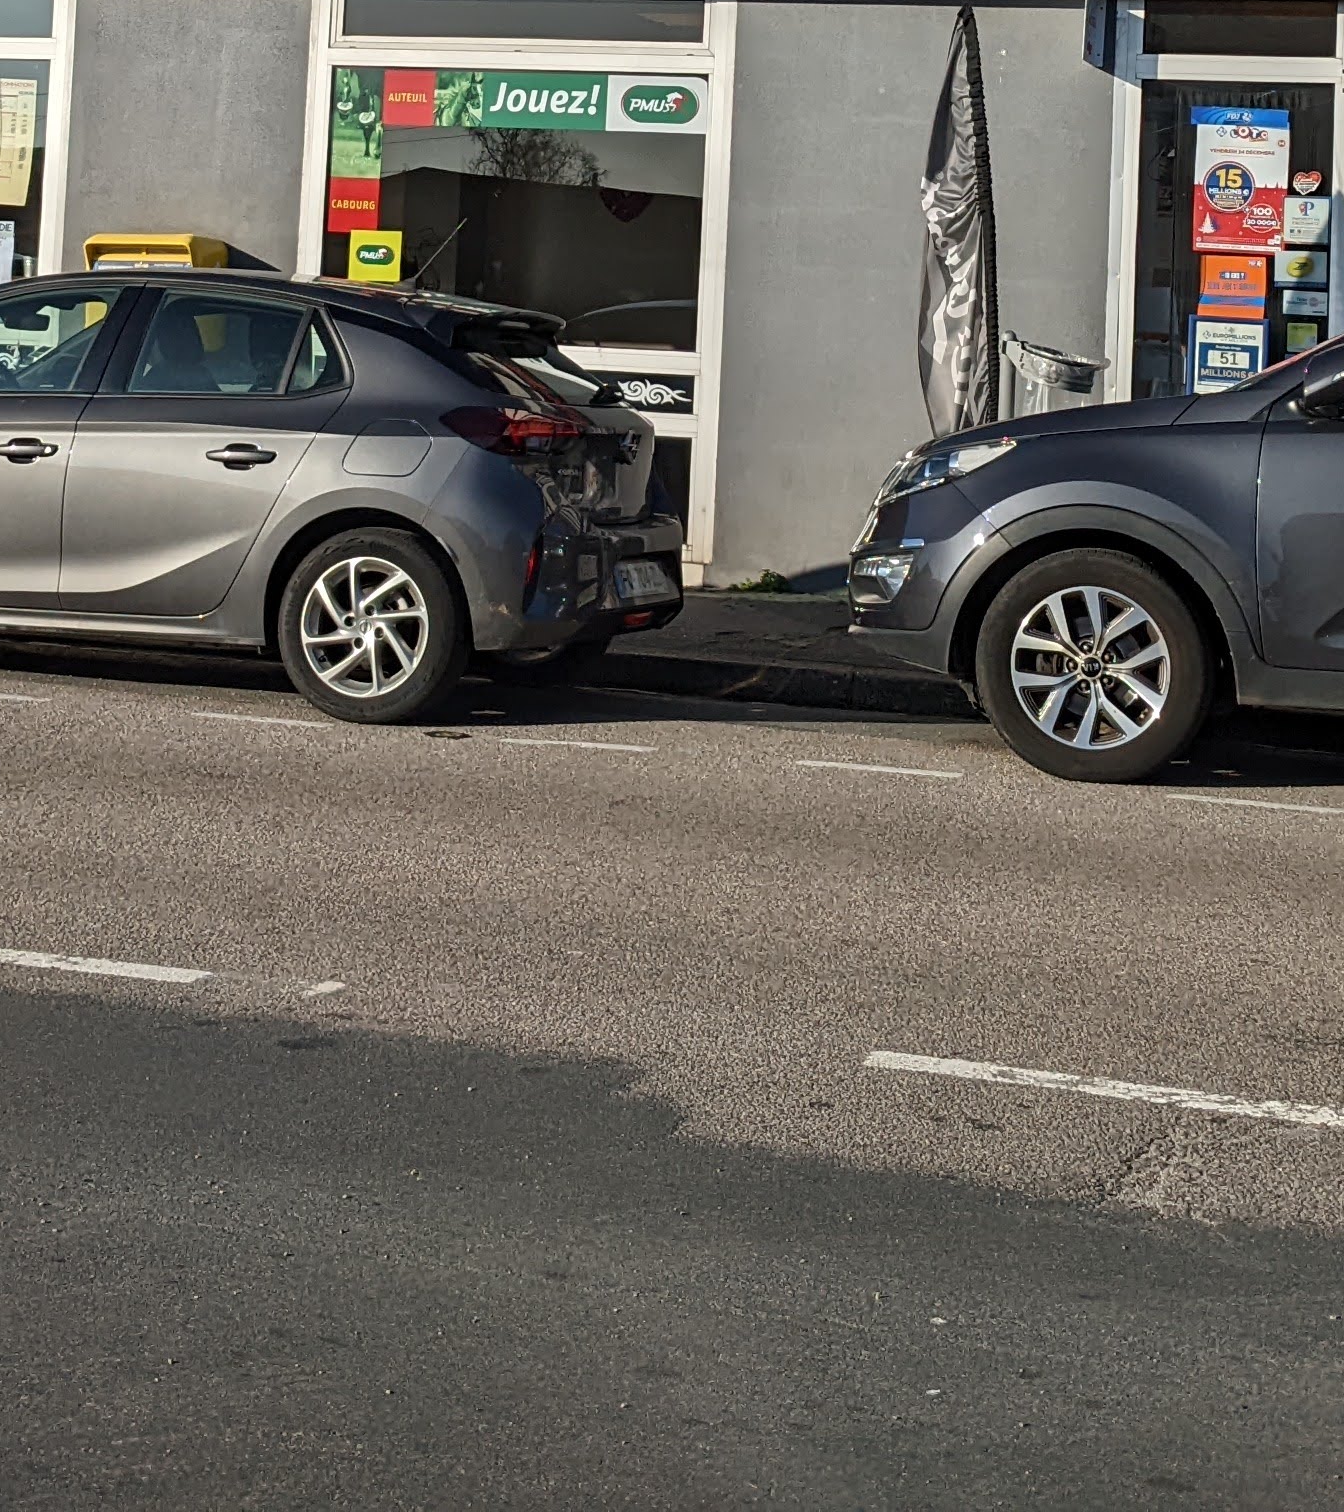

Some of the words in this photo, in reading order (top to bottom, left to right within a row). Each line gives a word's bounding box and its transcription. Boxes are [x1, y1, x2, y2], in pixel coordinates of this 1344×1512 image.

[387, 91, 428, 104] AUTEUIL
[490, 82, 600, 116] Jouez!
[629, 98, 665, 113] PMU
[1229, 125, 1269, 139] LOTO
[1215, 168, 1243, 188] 15
[331, 198, 376, 210] CABOURG
[1252, 207, 1273, 216] 100
[359, 250, 378, 260] PMU
[1212, 332, 1256, 341] EUROMILLIONS
[1219, 352, 1239, 366] 51
[1200, 367, 1247, 379] MILLIONS
